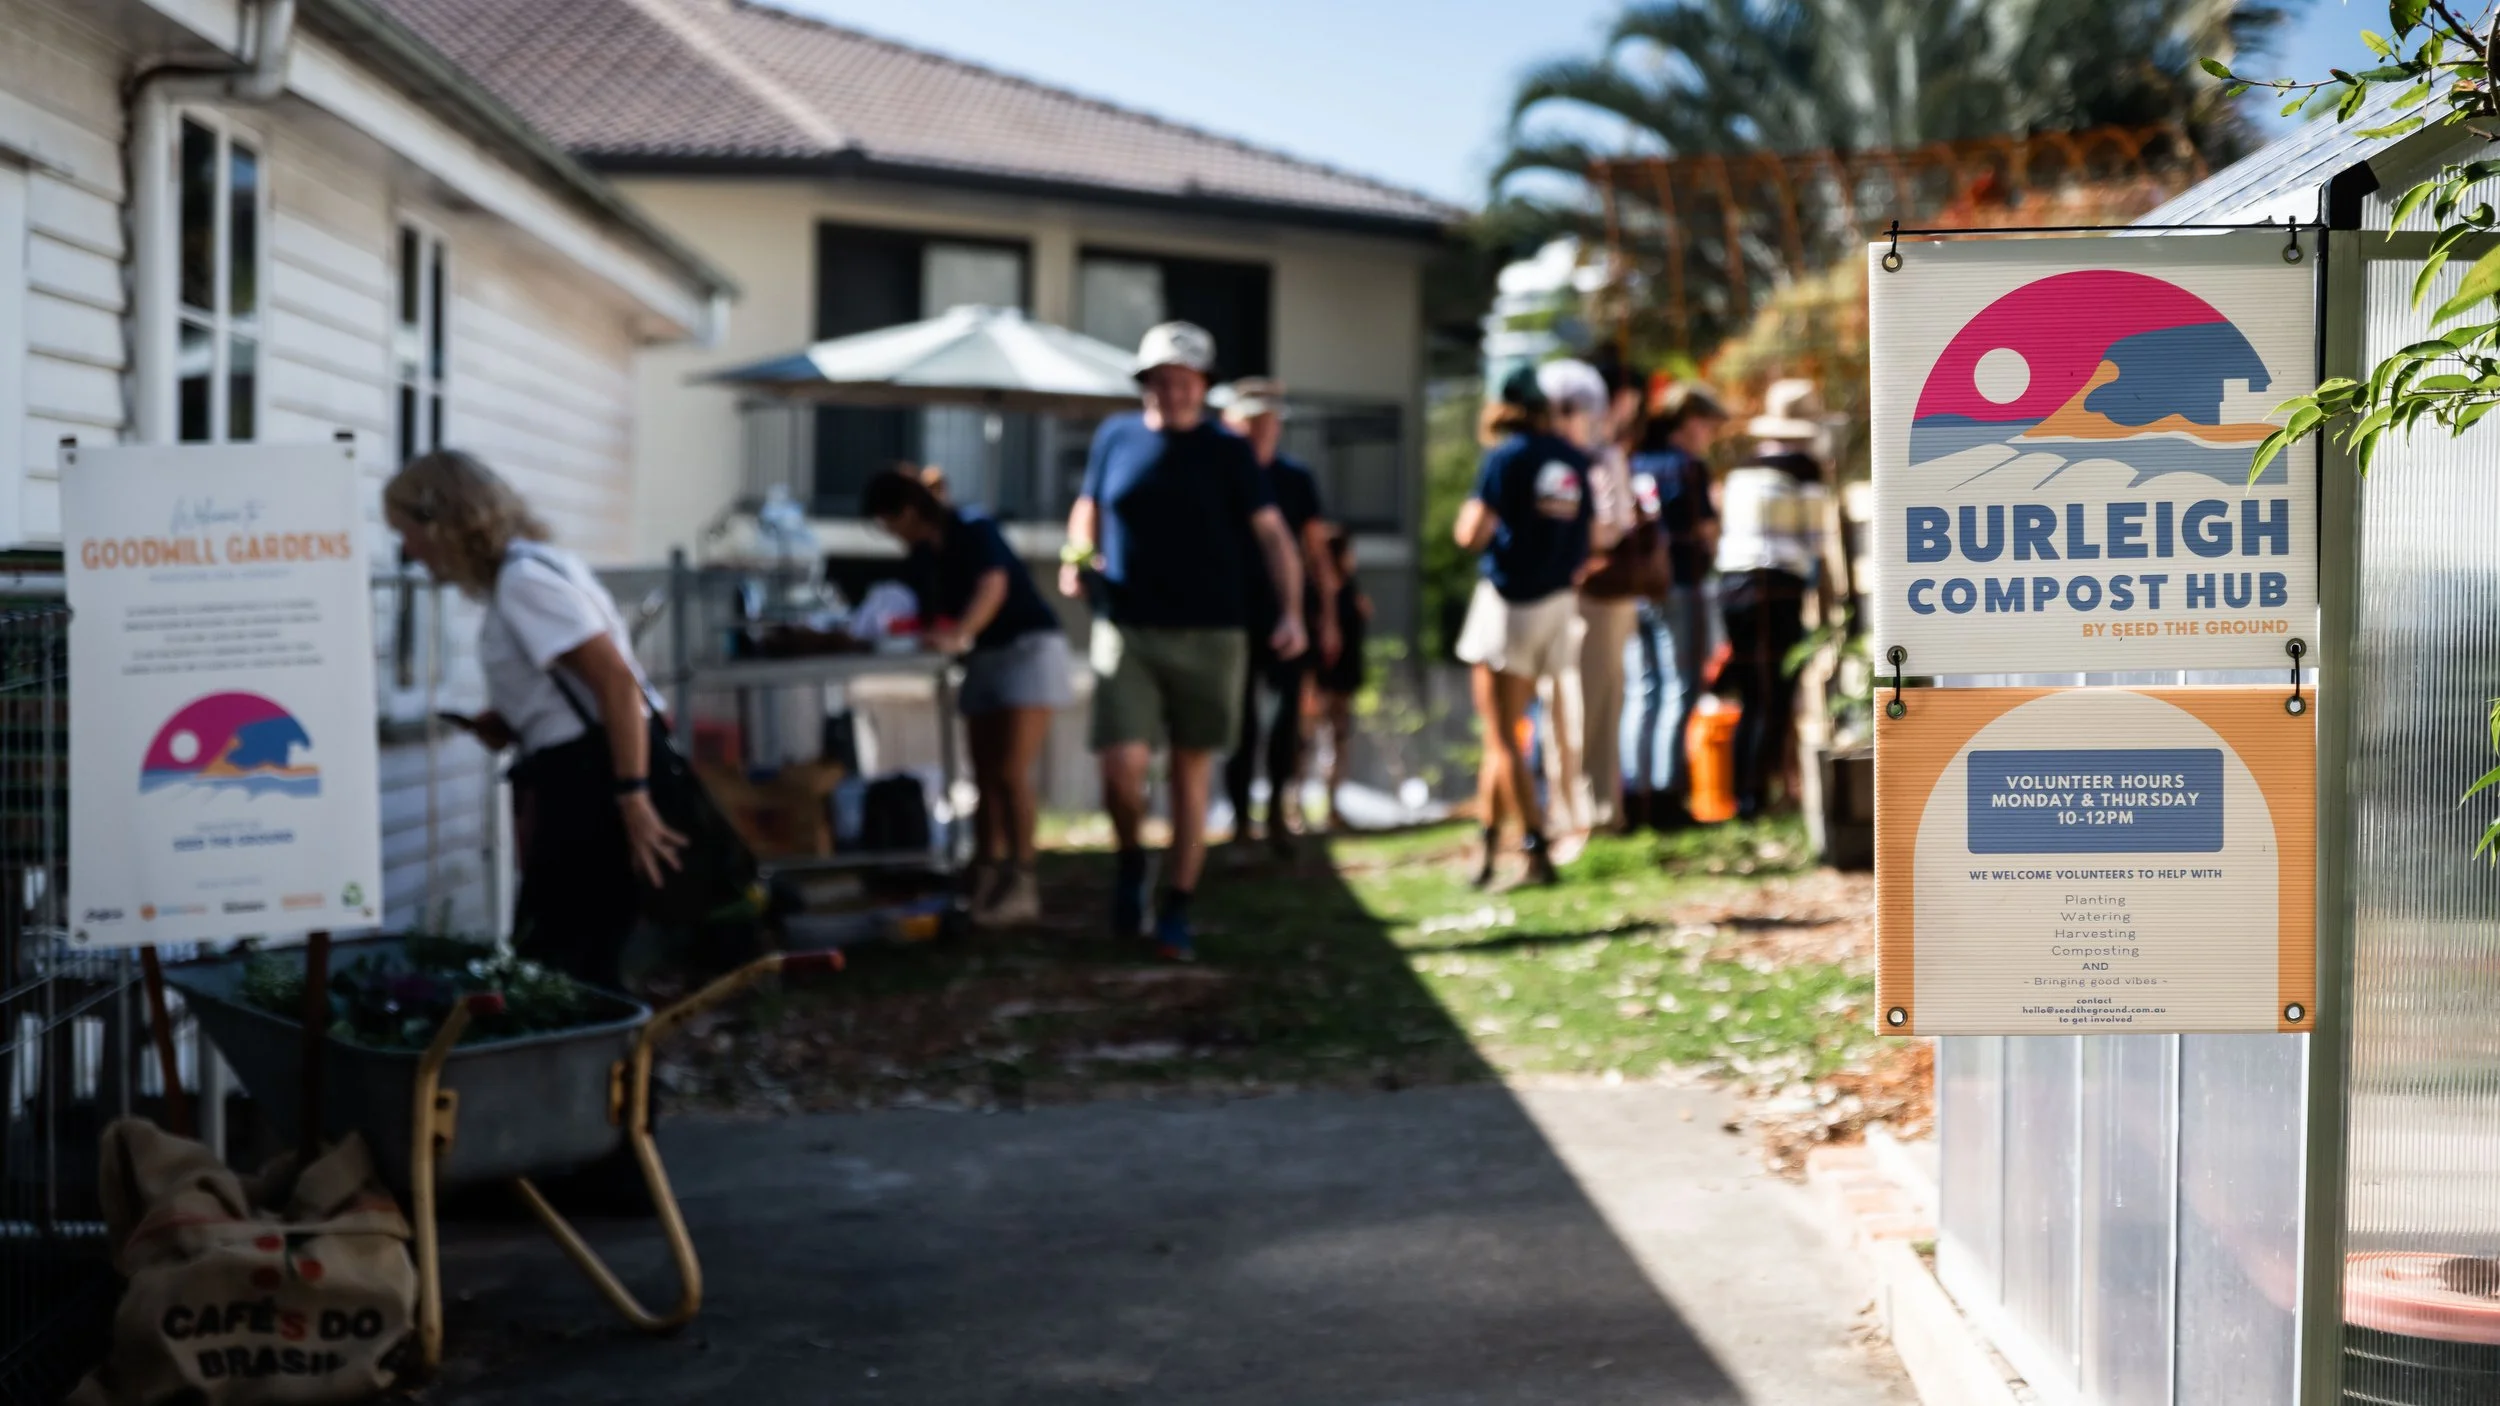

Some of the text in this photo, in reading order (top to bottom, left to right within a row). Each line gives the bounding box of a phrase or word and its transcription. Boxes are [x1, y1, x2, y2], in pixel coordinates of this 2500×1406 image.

[1907, 499, 2289, 563] BURLEIGH
[227, 531, 352, 563] GARDENS
[1907, 572, 2288, 614] COMPOST HUB
[2082, 620, 2288, 638] BY SEED THE GROUND
[2006, 774, 2185, 790] VOLUNTEER HOURS
[1992, 791, 2200, 808] MONDAY & THURSDAY
[2057, 811, 2134, 825] 10-12PM
[1970, 869, 2222, 880] WE WELCOME VOLUNTEERS TO HELP WITH
[2065, 894, 2126, 906] Planting
[2060, 912, 2131, 924] Watering
[2055, 928, 2136, 940] Harvesting
[2051, 945, 2139, 957] Composting
[2082, 962, 2109, 970] AND
[2034, 978, 2085, 987] Bringing
[2091, 978, 2120, 987] good
[2125, 977, 2157, 985] vibes
[2022, 1006, 2166, 1015] hello@seedtheground.com.au
[2072, 1016, 2088, 1024] get
[2090, 1015, 2132, 1023] involved
[320, 1308, 382, 1338] DO
